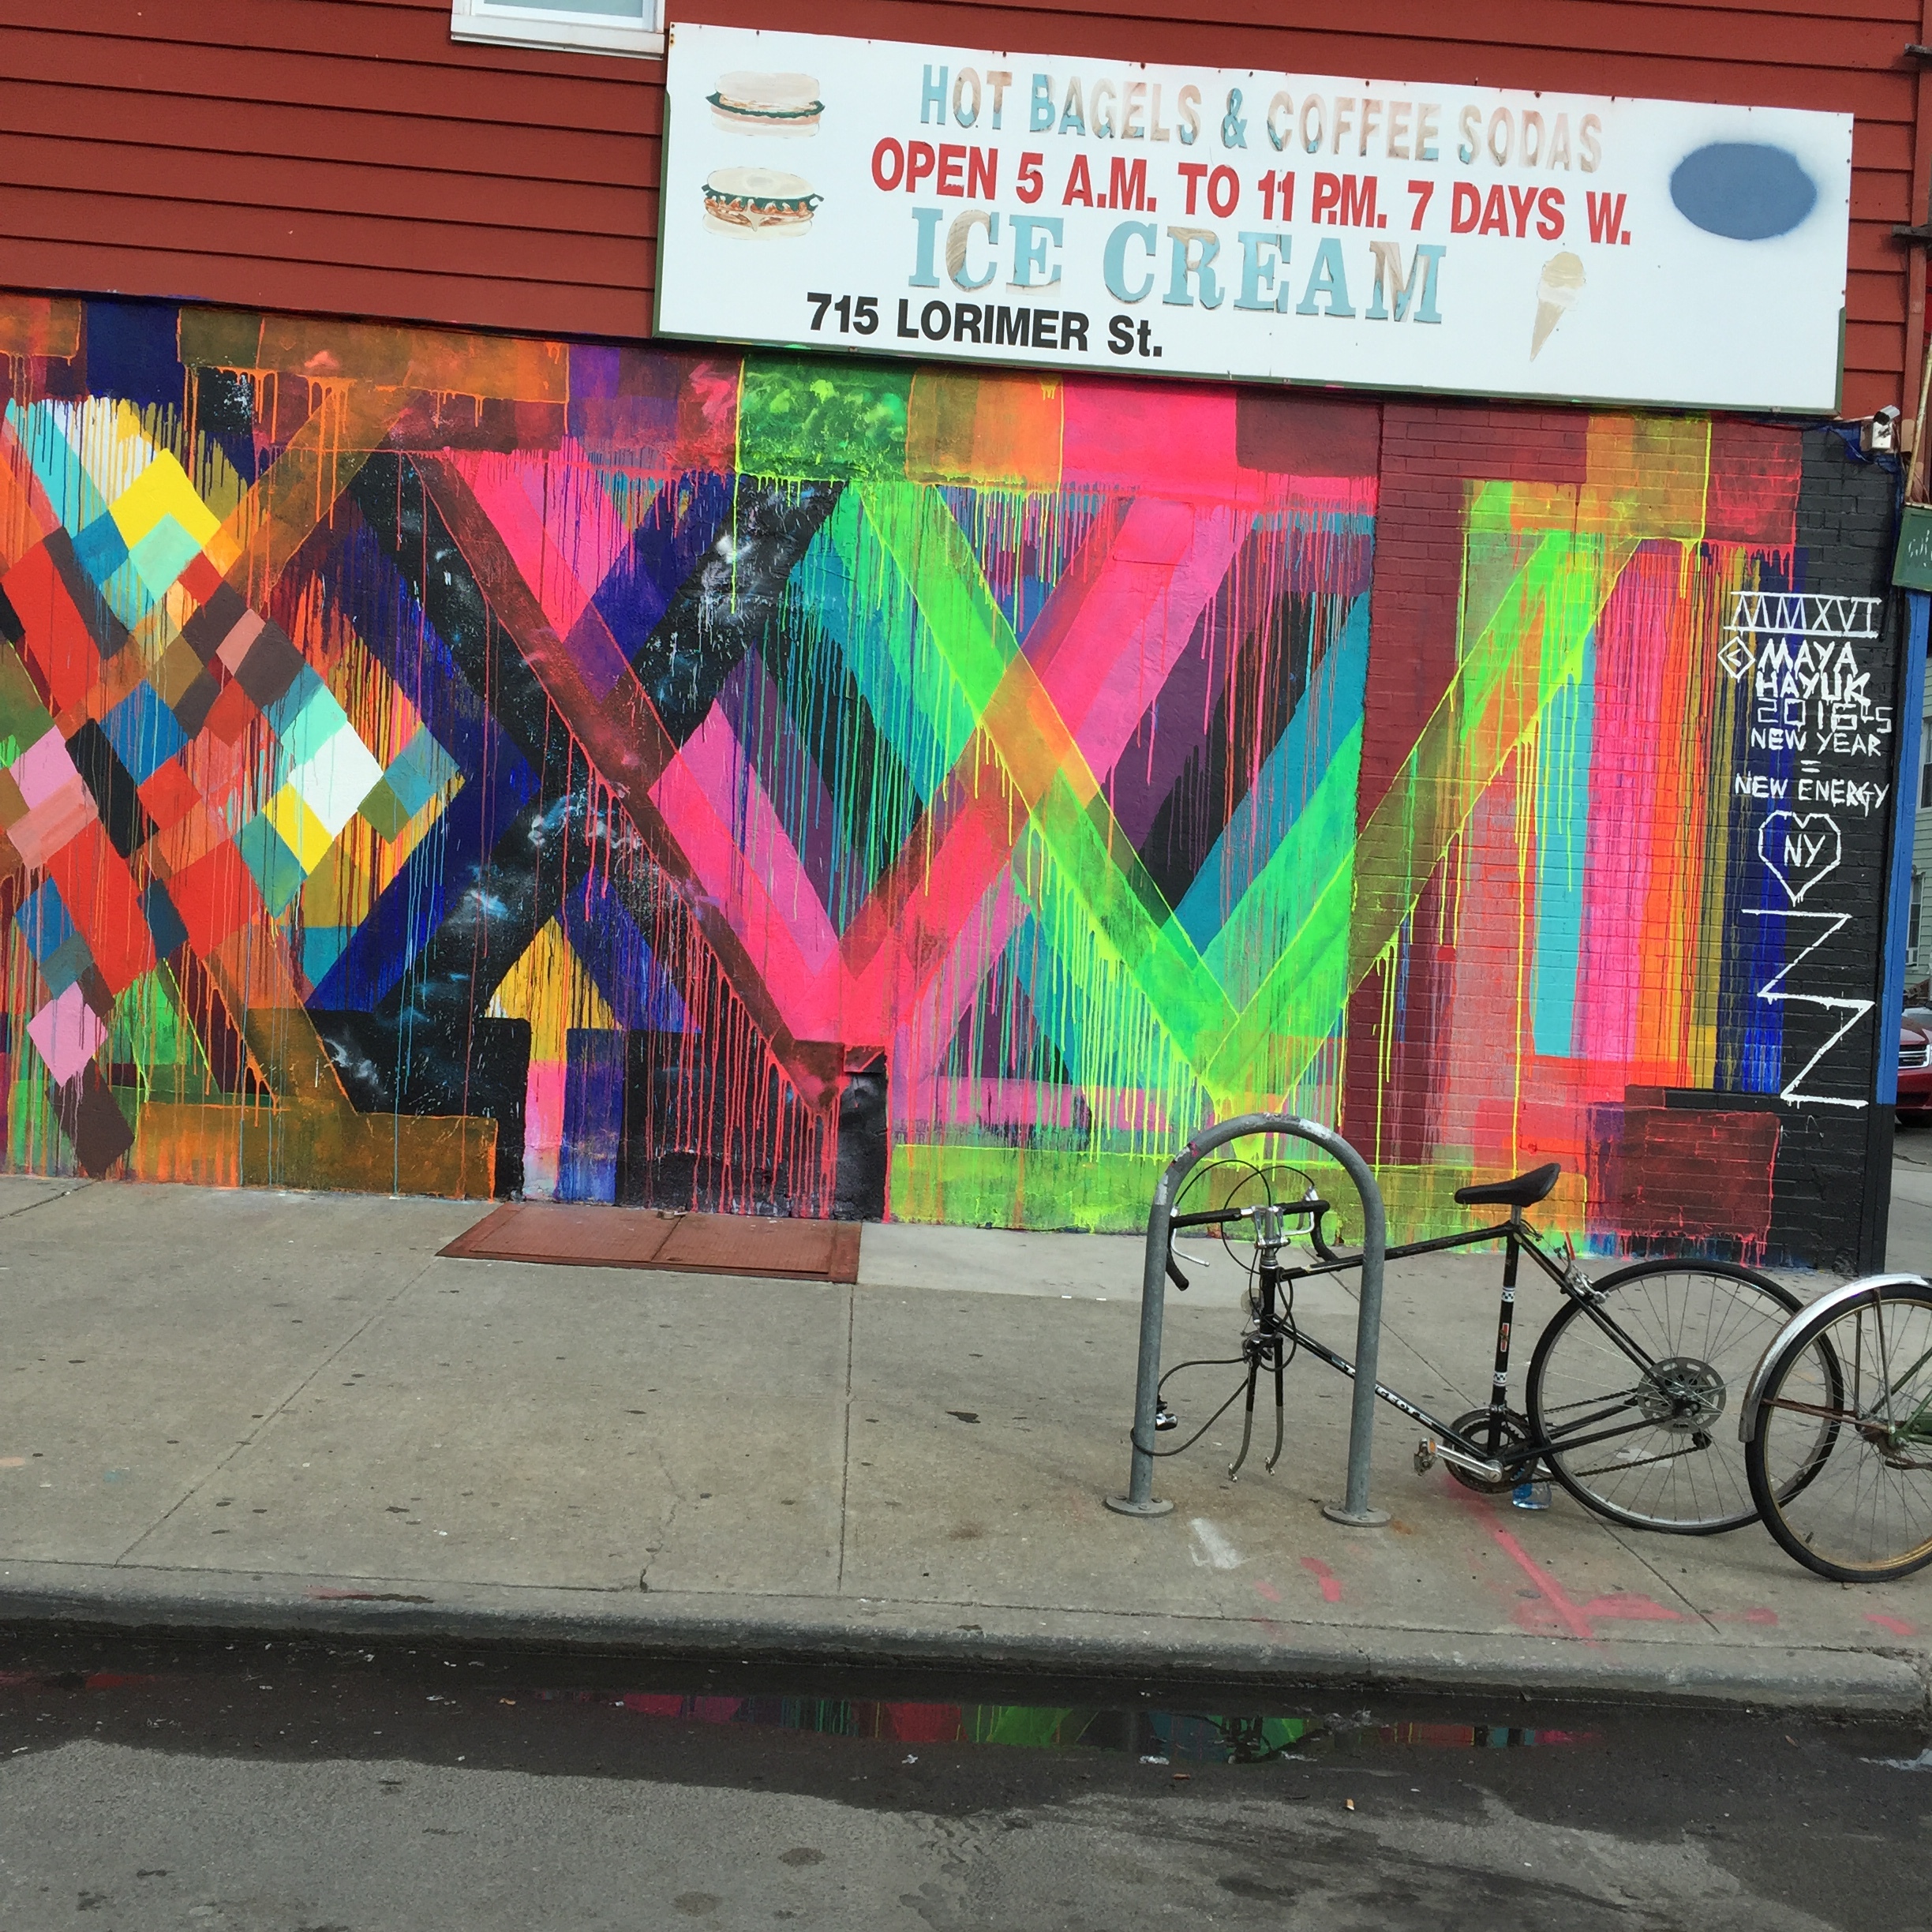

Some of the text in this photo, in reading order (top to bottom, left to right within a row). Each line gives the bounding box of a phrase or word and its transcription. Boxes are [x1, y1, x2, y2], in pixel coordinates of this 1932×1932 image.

[920, 65, 1603, 174] HOT BAGELS & COFFEE SODAS
[871, 137, 1631, 245] OPEN 5 A.M. TO 11 P.M. 7 DAYS W.
[908, 207, 1447, 324] ICE CREAM
[807, 292, 1163, 358] 715 LORIMER St.
[1758, 638, 1859, 676] MAYA
[1755, 671, 1870, 704] HAYUK
[1750, 728, 1881, 756] NEW YEAR
[1734, 772, 1890, 816] NEW ENERGY
[1784, 833, 1826, 868] NY
